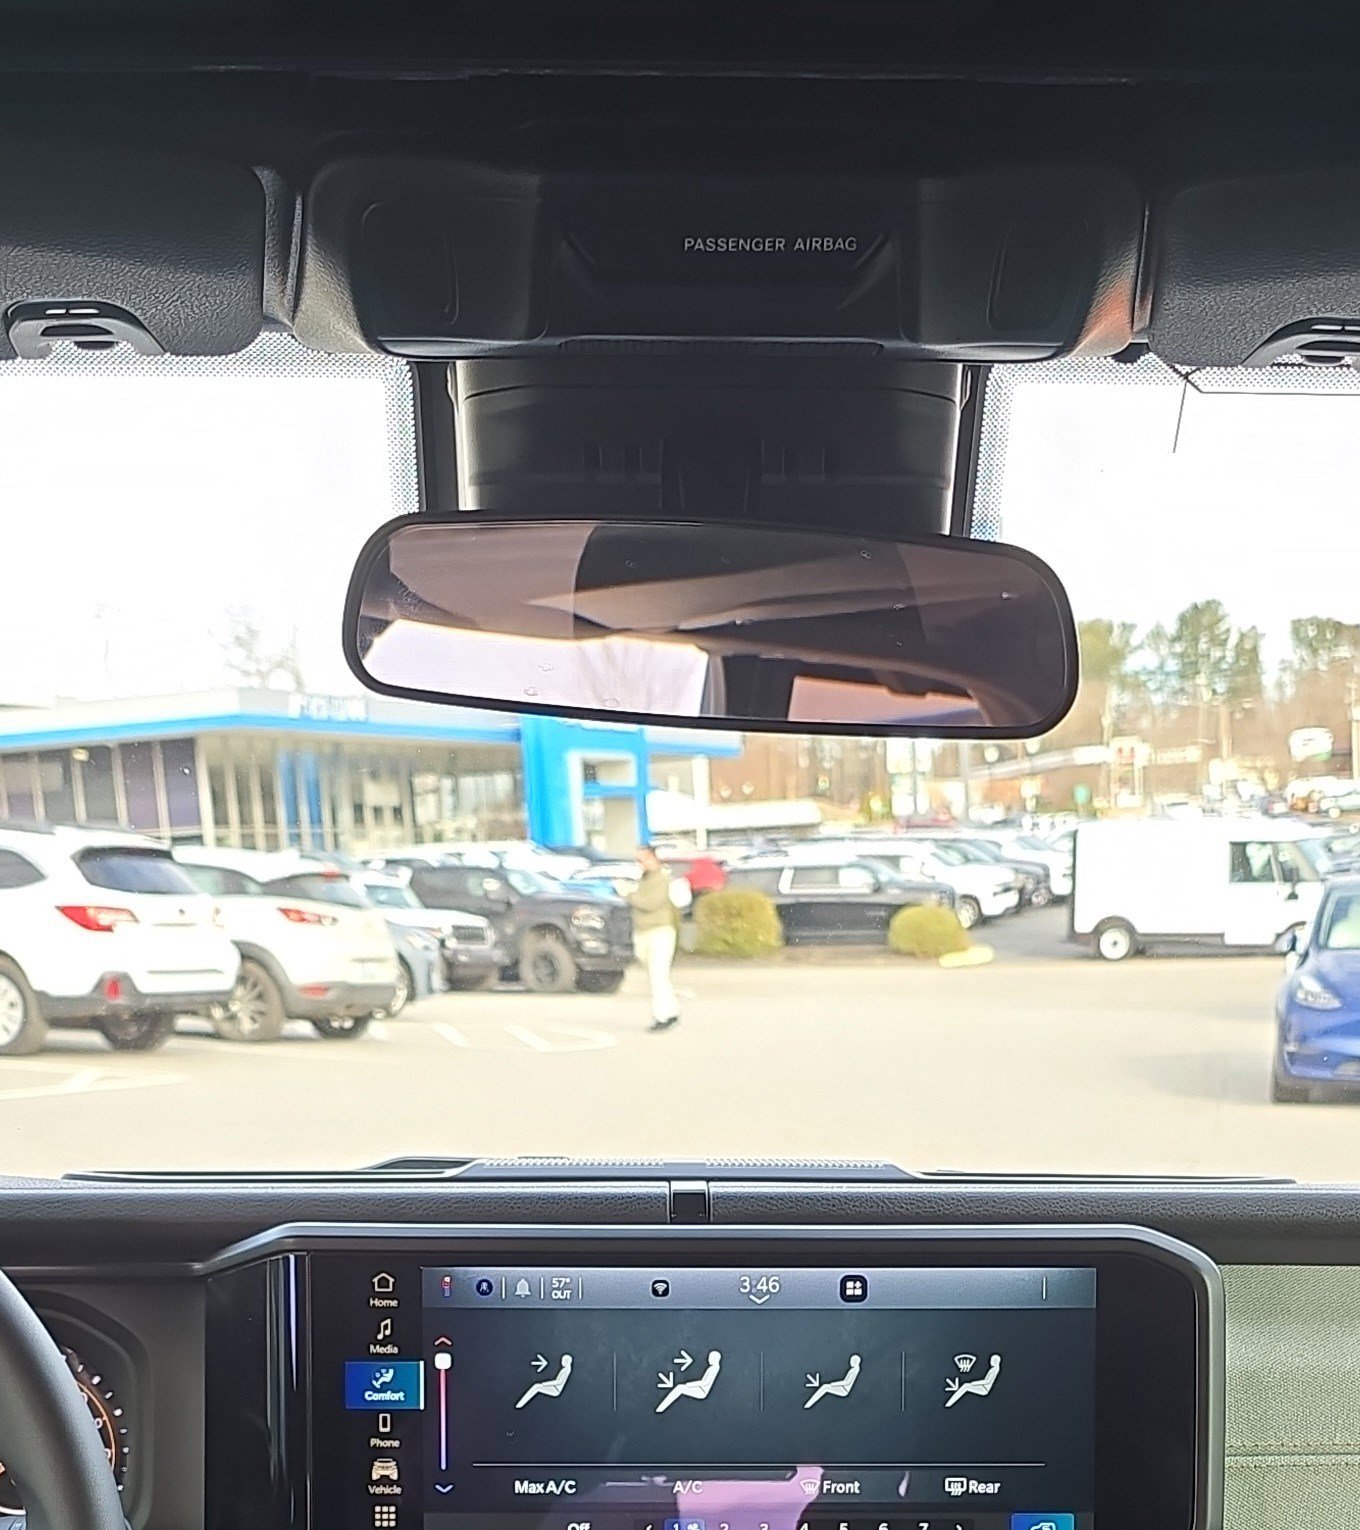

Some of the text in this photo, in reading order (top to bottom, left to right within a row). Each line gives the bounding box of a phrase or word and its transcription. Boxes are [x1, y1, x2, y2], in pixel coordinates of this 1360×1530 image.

[684, 237, 857, 252] PASSENGER AIRBAG
[740, 1276, 780, 1293] 3:46
[551, 1290, 572, 1300] OUT
[369, 1297, 399, 1307] Home
[369, 1344, 399, 1355] Media
[364, 1390, 405, 1401] Comfort
[370, 1438, 401, 1449] Phone
[368, 1484, 403, 1496] Vehicle
[514, 1480, 577, 1496] Max A/C
[672, 1480, 704, 1496] A/C
[823, 1481, 861, 1495] Front
[969, 1481, 1001, 1495] Rear
